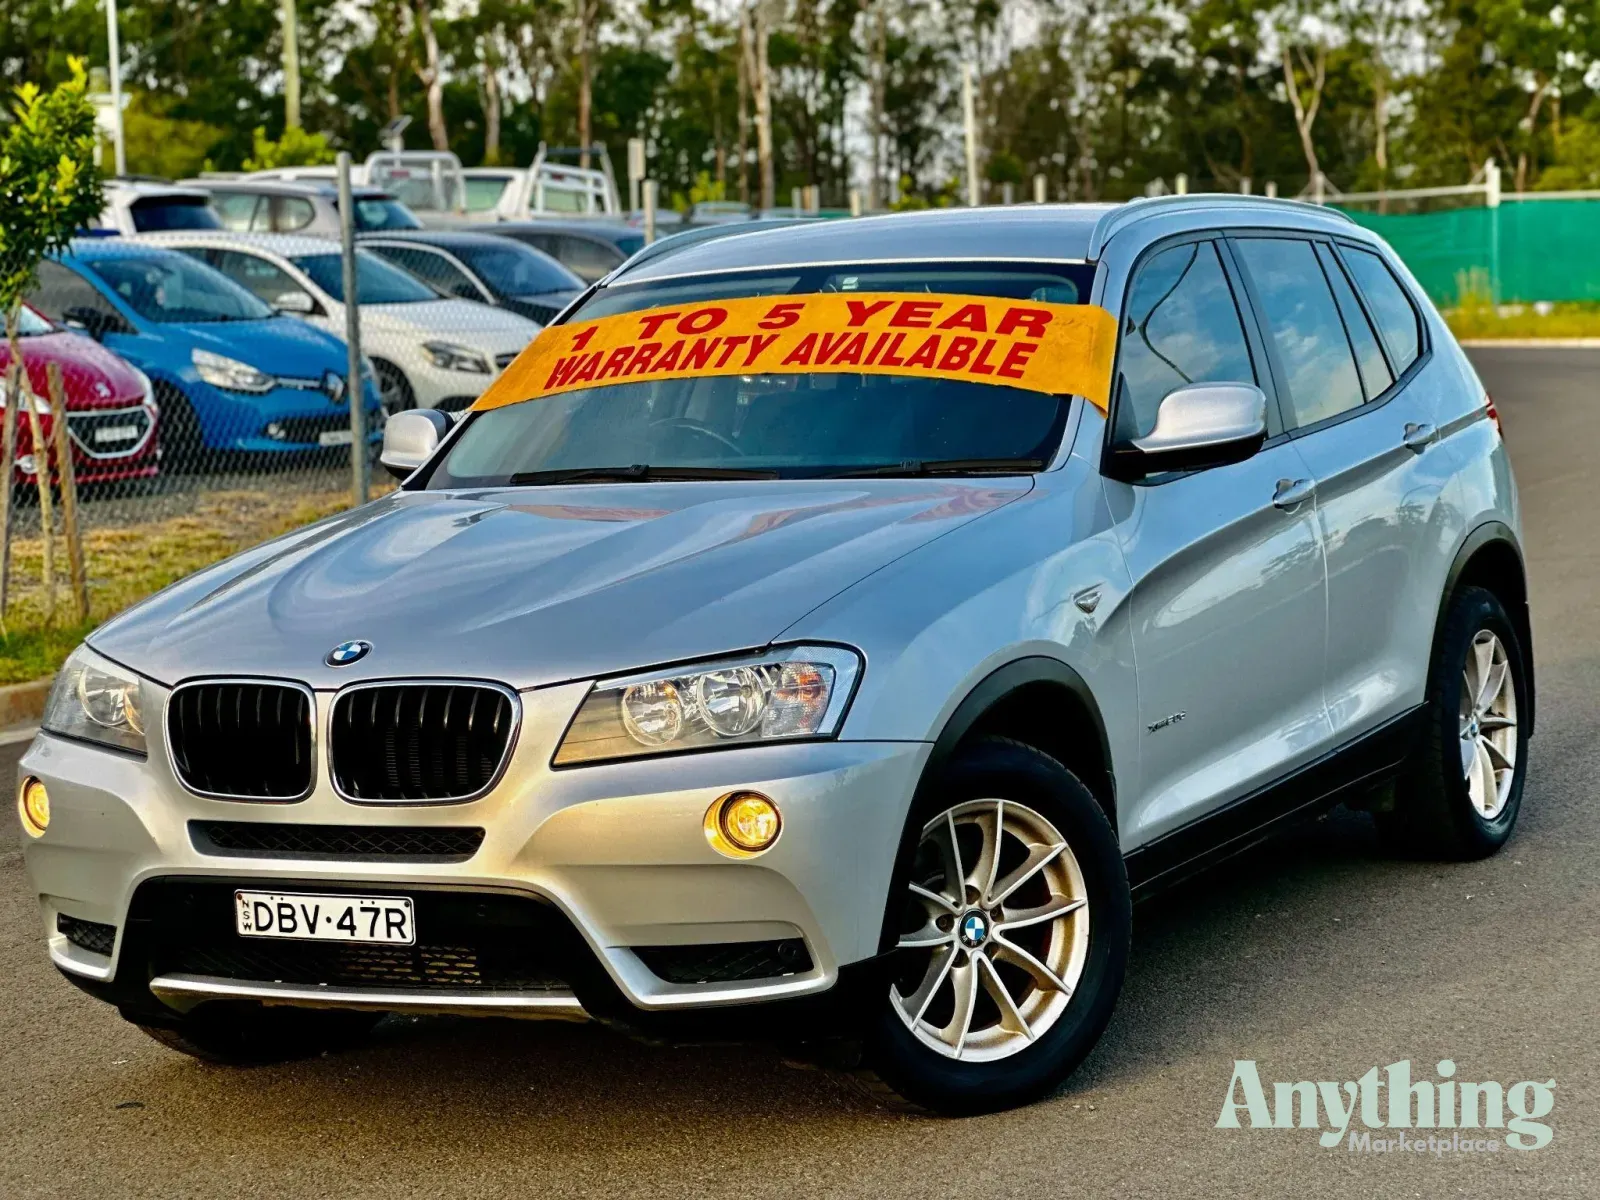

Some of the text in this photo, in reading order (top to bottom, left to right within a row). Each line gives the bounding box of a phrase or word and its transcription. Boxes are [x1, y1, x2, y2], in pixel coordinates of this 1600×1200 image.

[572, 300, 1054, 352] 1 TO 5 YEAR
[543, 332, 1039, 390] WARRANTY AVAILABLE
